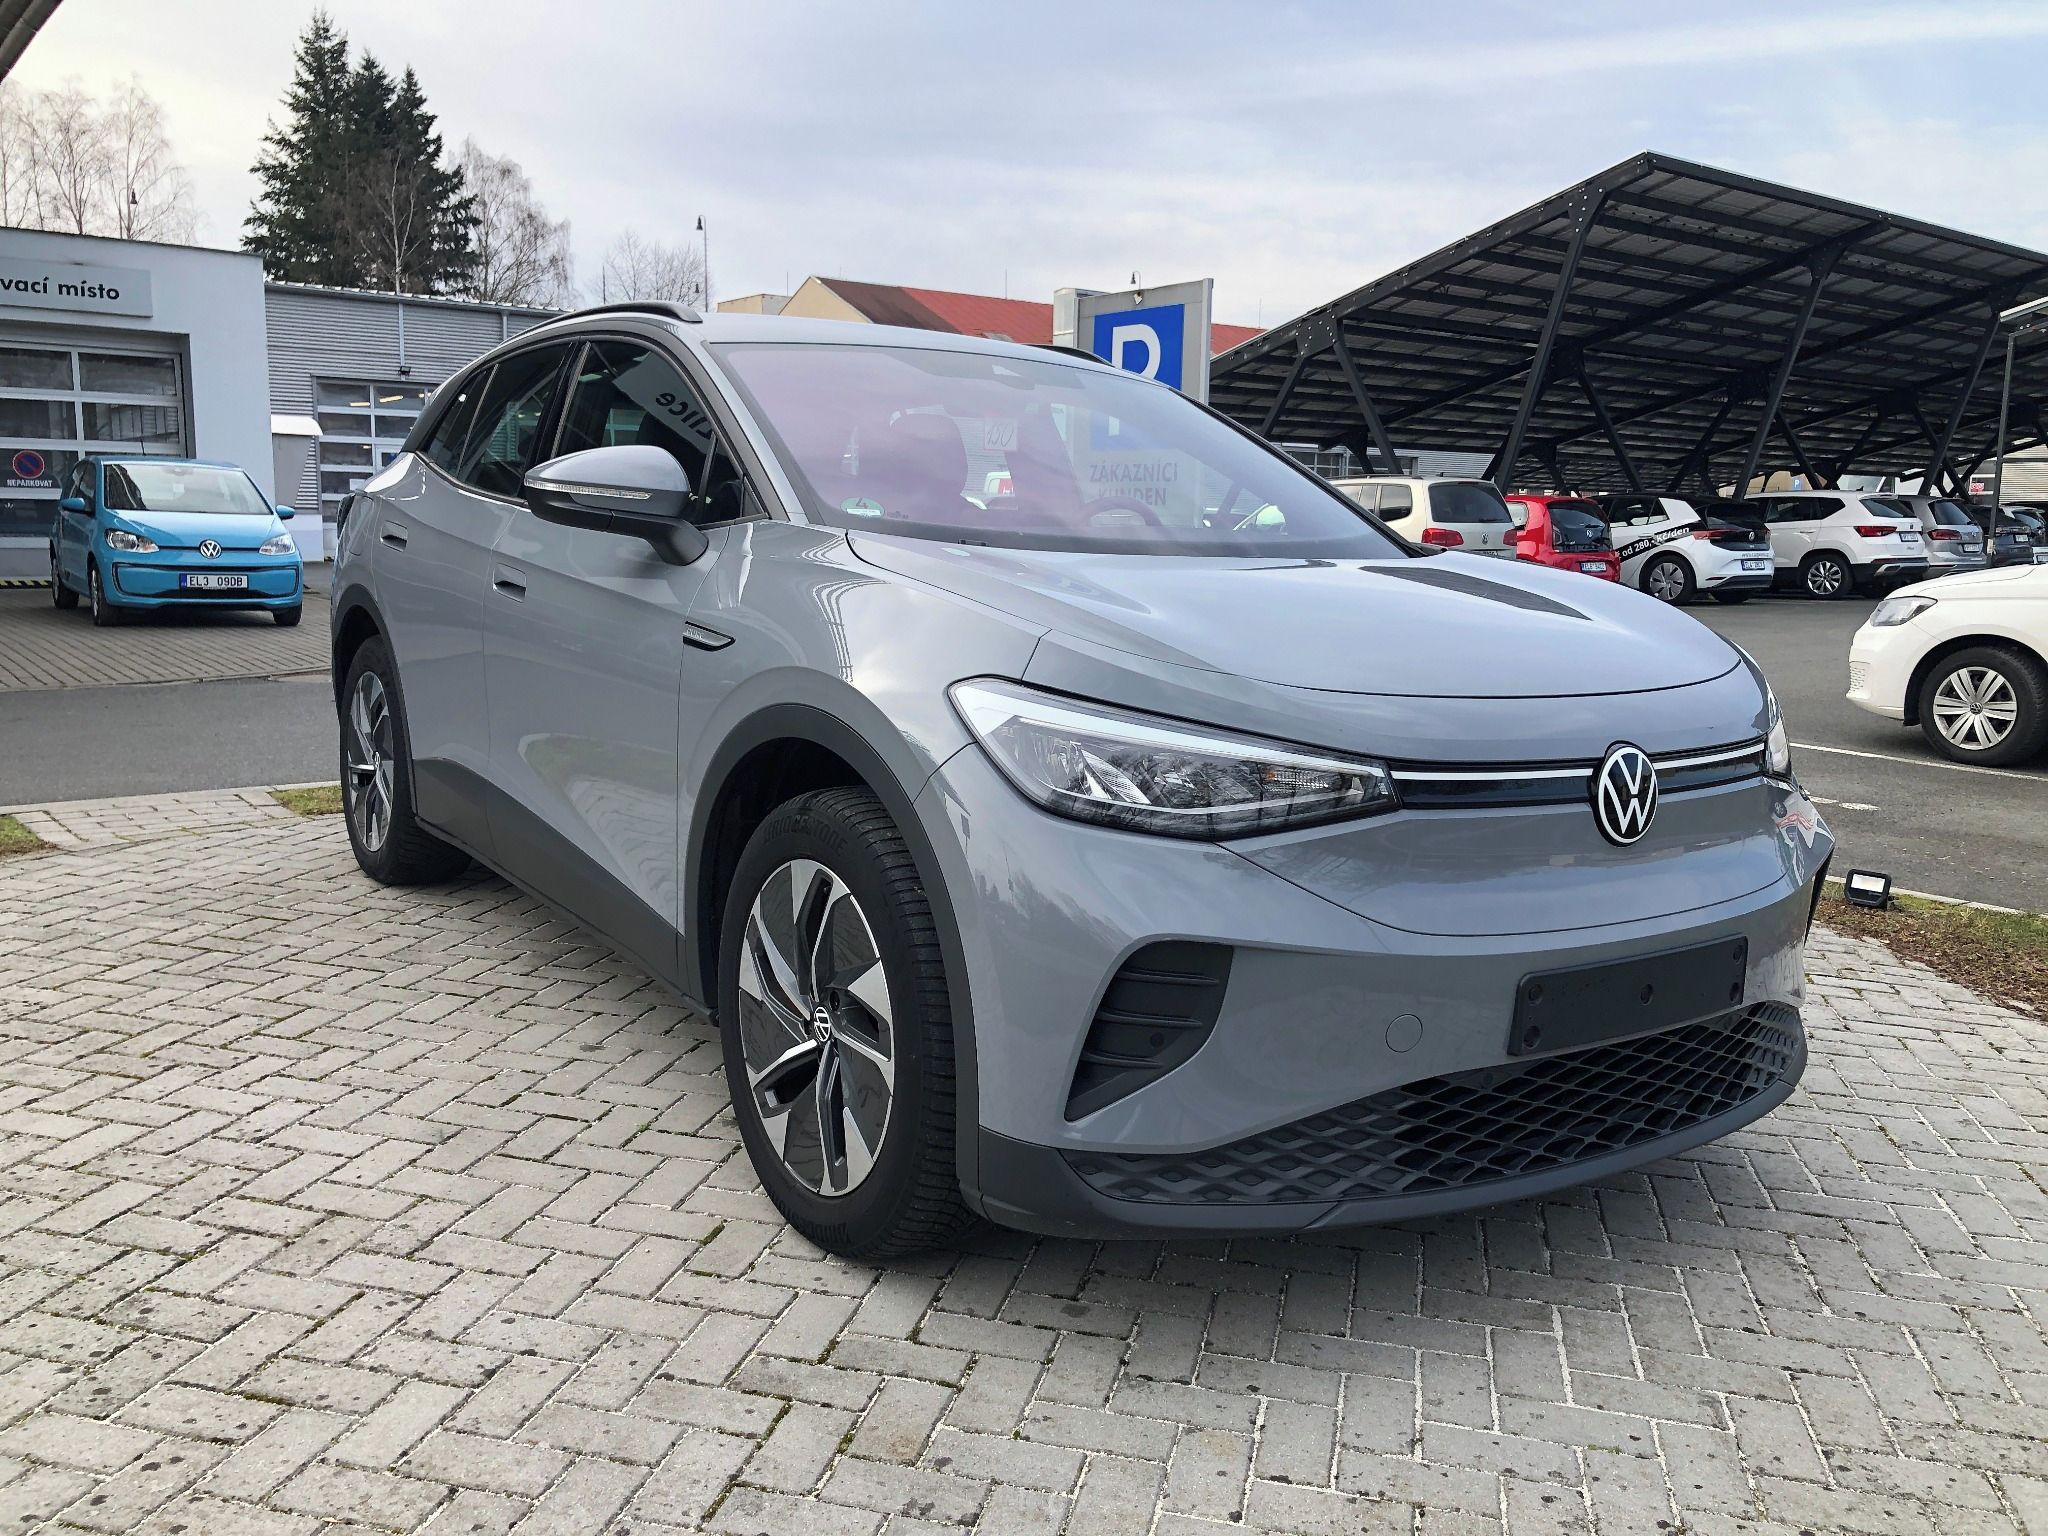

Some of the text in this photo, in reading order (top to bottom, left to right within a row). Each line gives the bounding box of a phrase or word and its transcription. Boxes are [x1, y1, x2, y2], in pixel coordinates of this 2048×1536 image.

[58, 280, 120, 300] místo
[1623, 545, 1634, 556] od
[1656, 526, 1690, 543] Kč/den
[189, 576, 209, 586] EL3
[217, 576, 243, 587] 09DB
